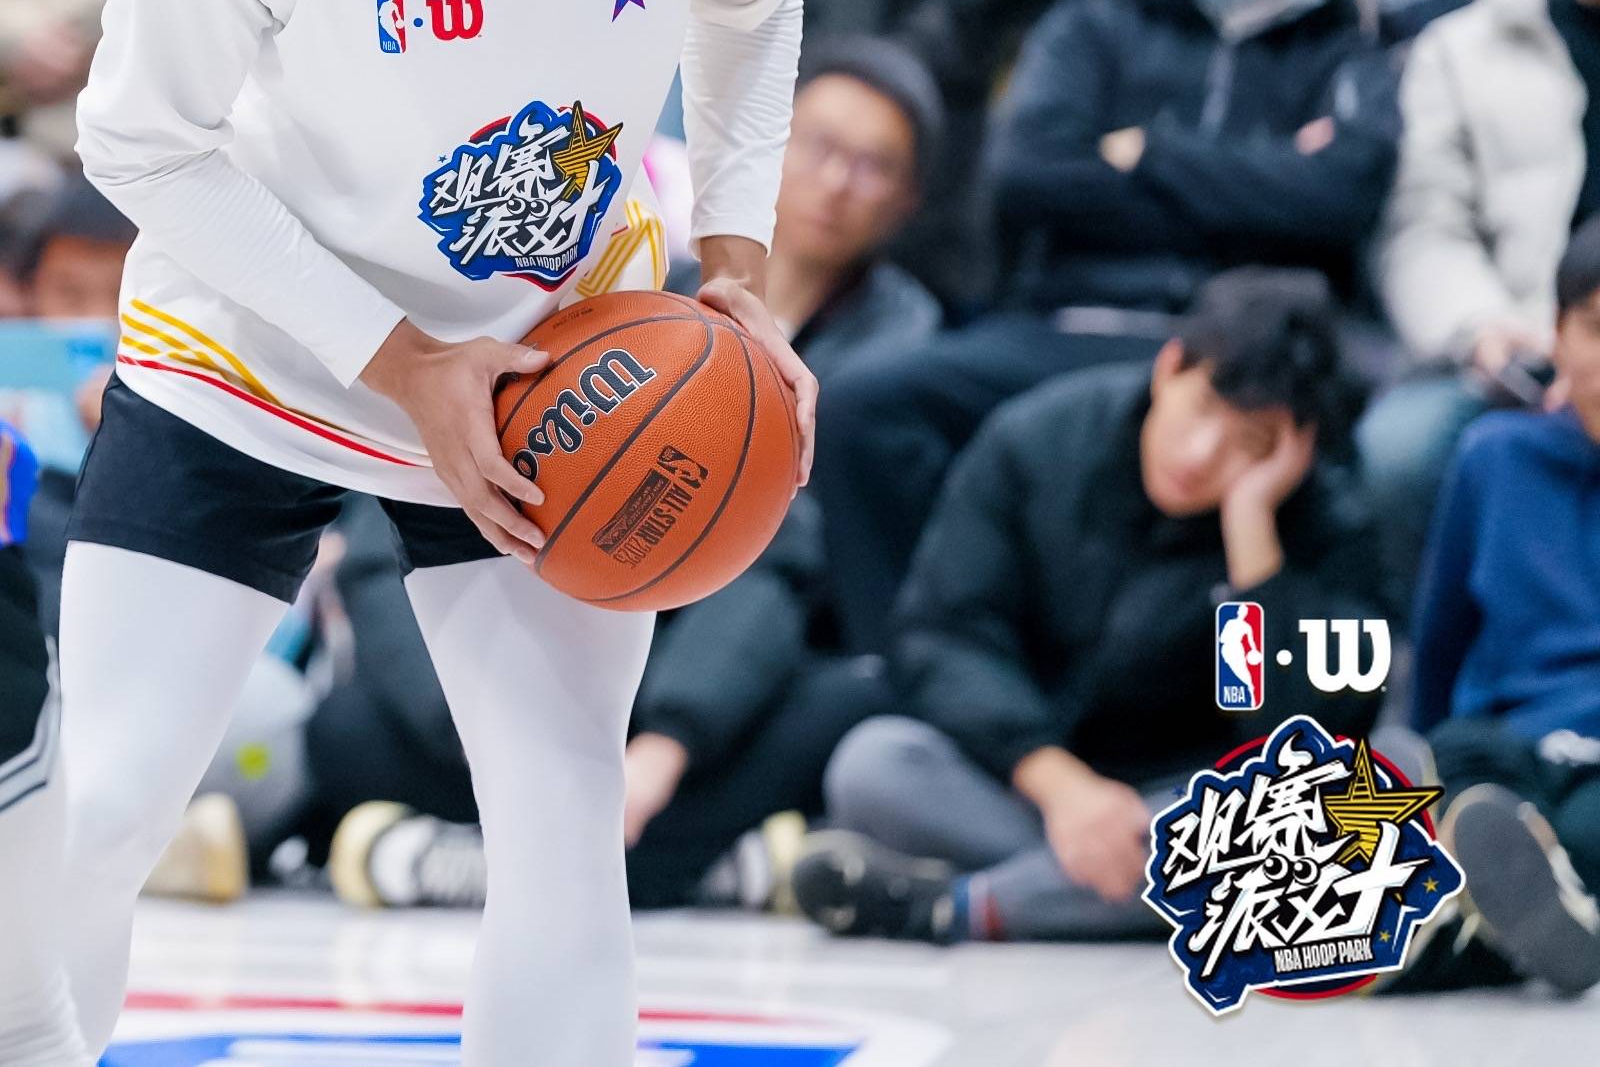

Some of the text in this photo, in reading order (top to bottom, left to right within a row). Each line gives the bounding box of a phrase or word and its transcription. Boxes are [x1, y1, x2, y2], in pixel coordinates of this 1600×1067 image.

[382, 40, 397, 52] NBA
[515, 256, 536, 268] NBA
[536, 256, 561, 272] HOOP
[512, 348, 657, 483] Wilso
[613, 535, 652, 569] 2025
